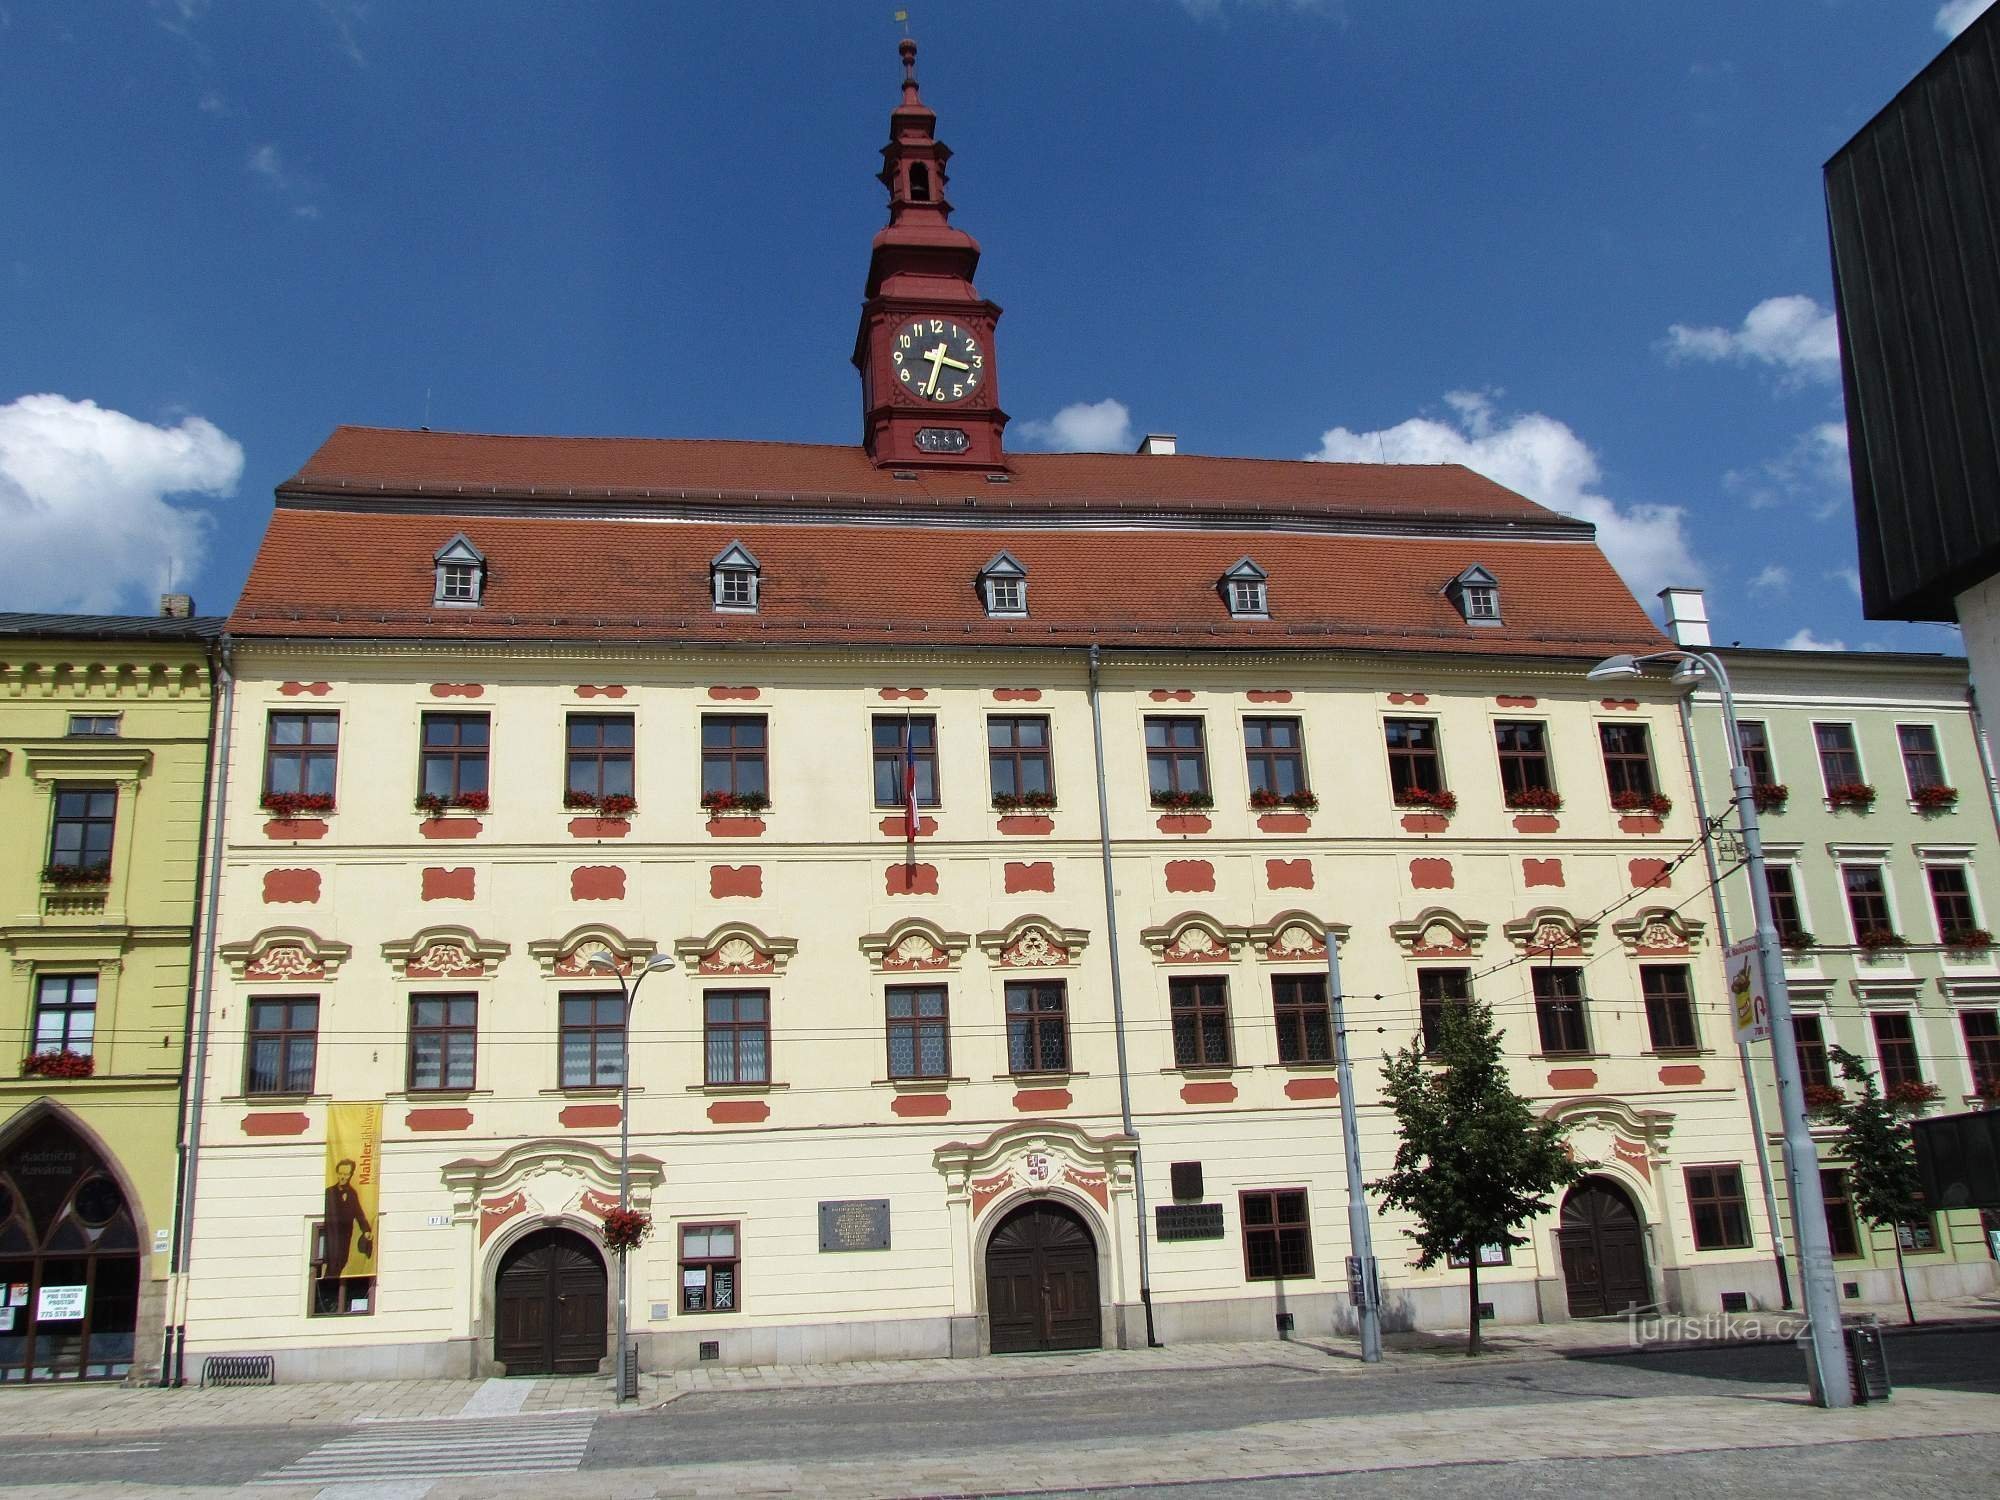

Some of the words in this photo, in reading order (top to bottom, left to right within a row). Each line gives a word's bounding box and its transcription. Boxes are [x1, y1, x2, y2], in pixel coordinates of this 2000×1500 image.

[913, 323, 923, 337] 11
[930, 319, 943, 333] 12
[952, 324, 957, 338] 1
[899, 334, 911, 348] 10
[965, 338, 975, 352] 2
[893, 351, 904, 365] 9
[972, 355, 983, 368] 3
[900, 368, 910, 382] 8
[966, 373, 977, 387] 4
[917, 382, 926, 396] 7
[935, 388, 945, 401] 6
[953, 384, 963, 397] 5
